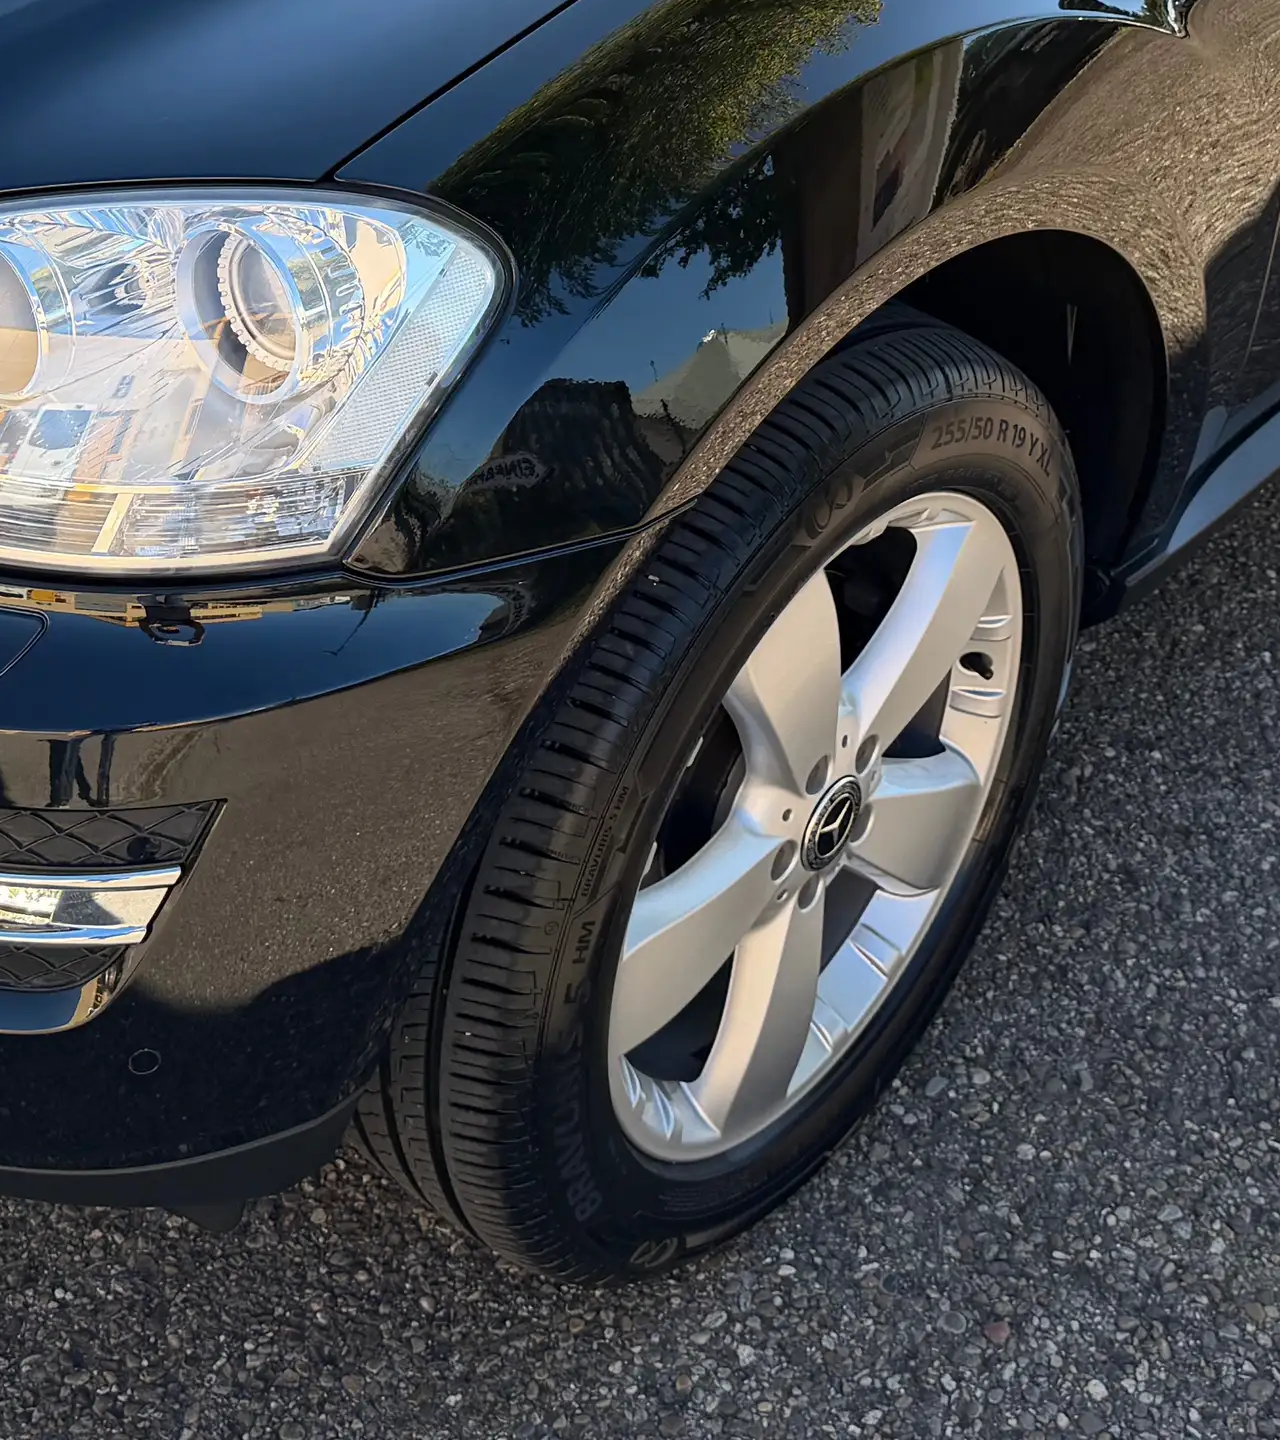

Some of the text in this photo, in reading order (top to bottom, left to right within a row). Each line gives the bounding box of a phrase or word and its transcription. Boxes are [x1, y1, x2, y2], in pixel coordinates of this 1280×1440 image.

[931, 416, 1052, 477] 255/50 R 19 Y XL
